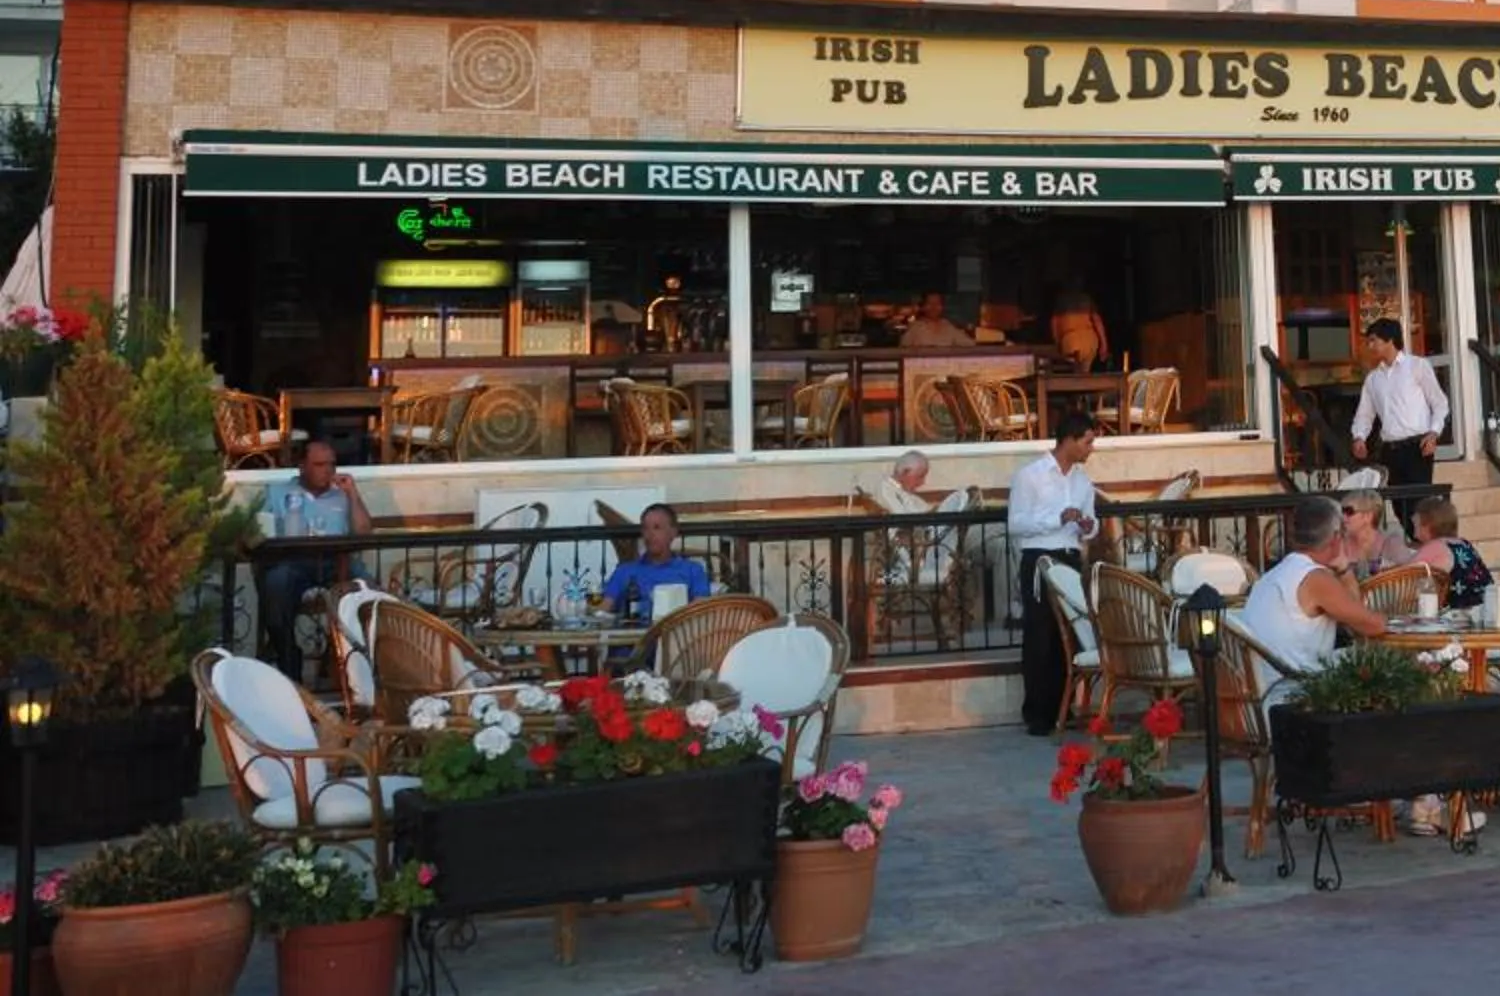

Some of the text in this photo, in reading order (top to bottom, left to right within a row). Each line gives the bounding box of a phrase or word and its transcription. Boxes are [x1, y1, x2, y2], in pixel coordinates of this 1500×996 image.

[814, 36, 920, 64] IRISH
[1023, 45, 1291, 108] LADIES
[830, 79, 907, 105] PUB
[1260, 106, 1349, 123] Since 1960
[357, 162, 1099, 197] LADIES BEACH RESTAURANT & CAFE & BAR
[1302, 168, 1476, 192] IRISH PUB
